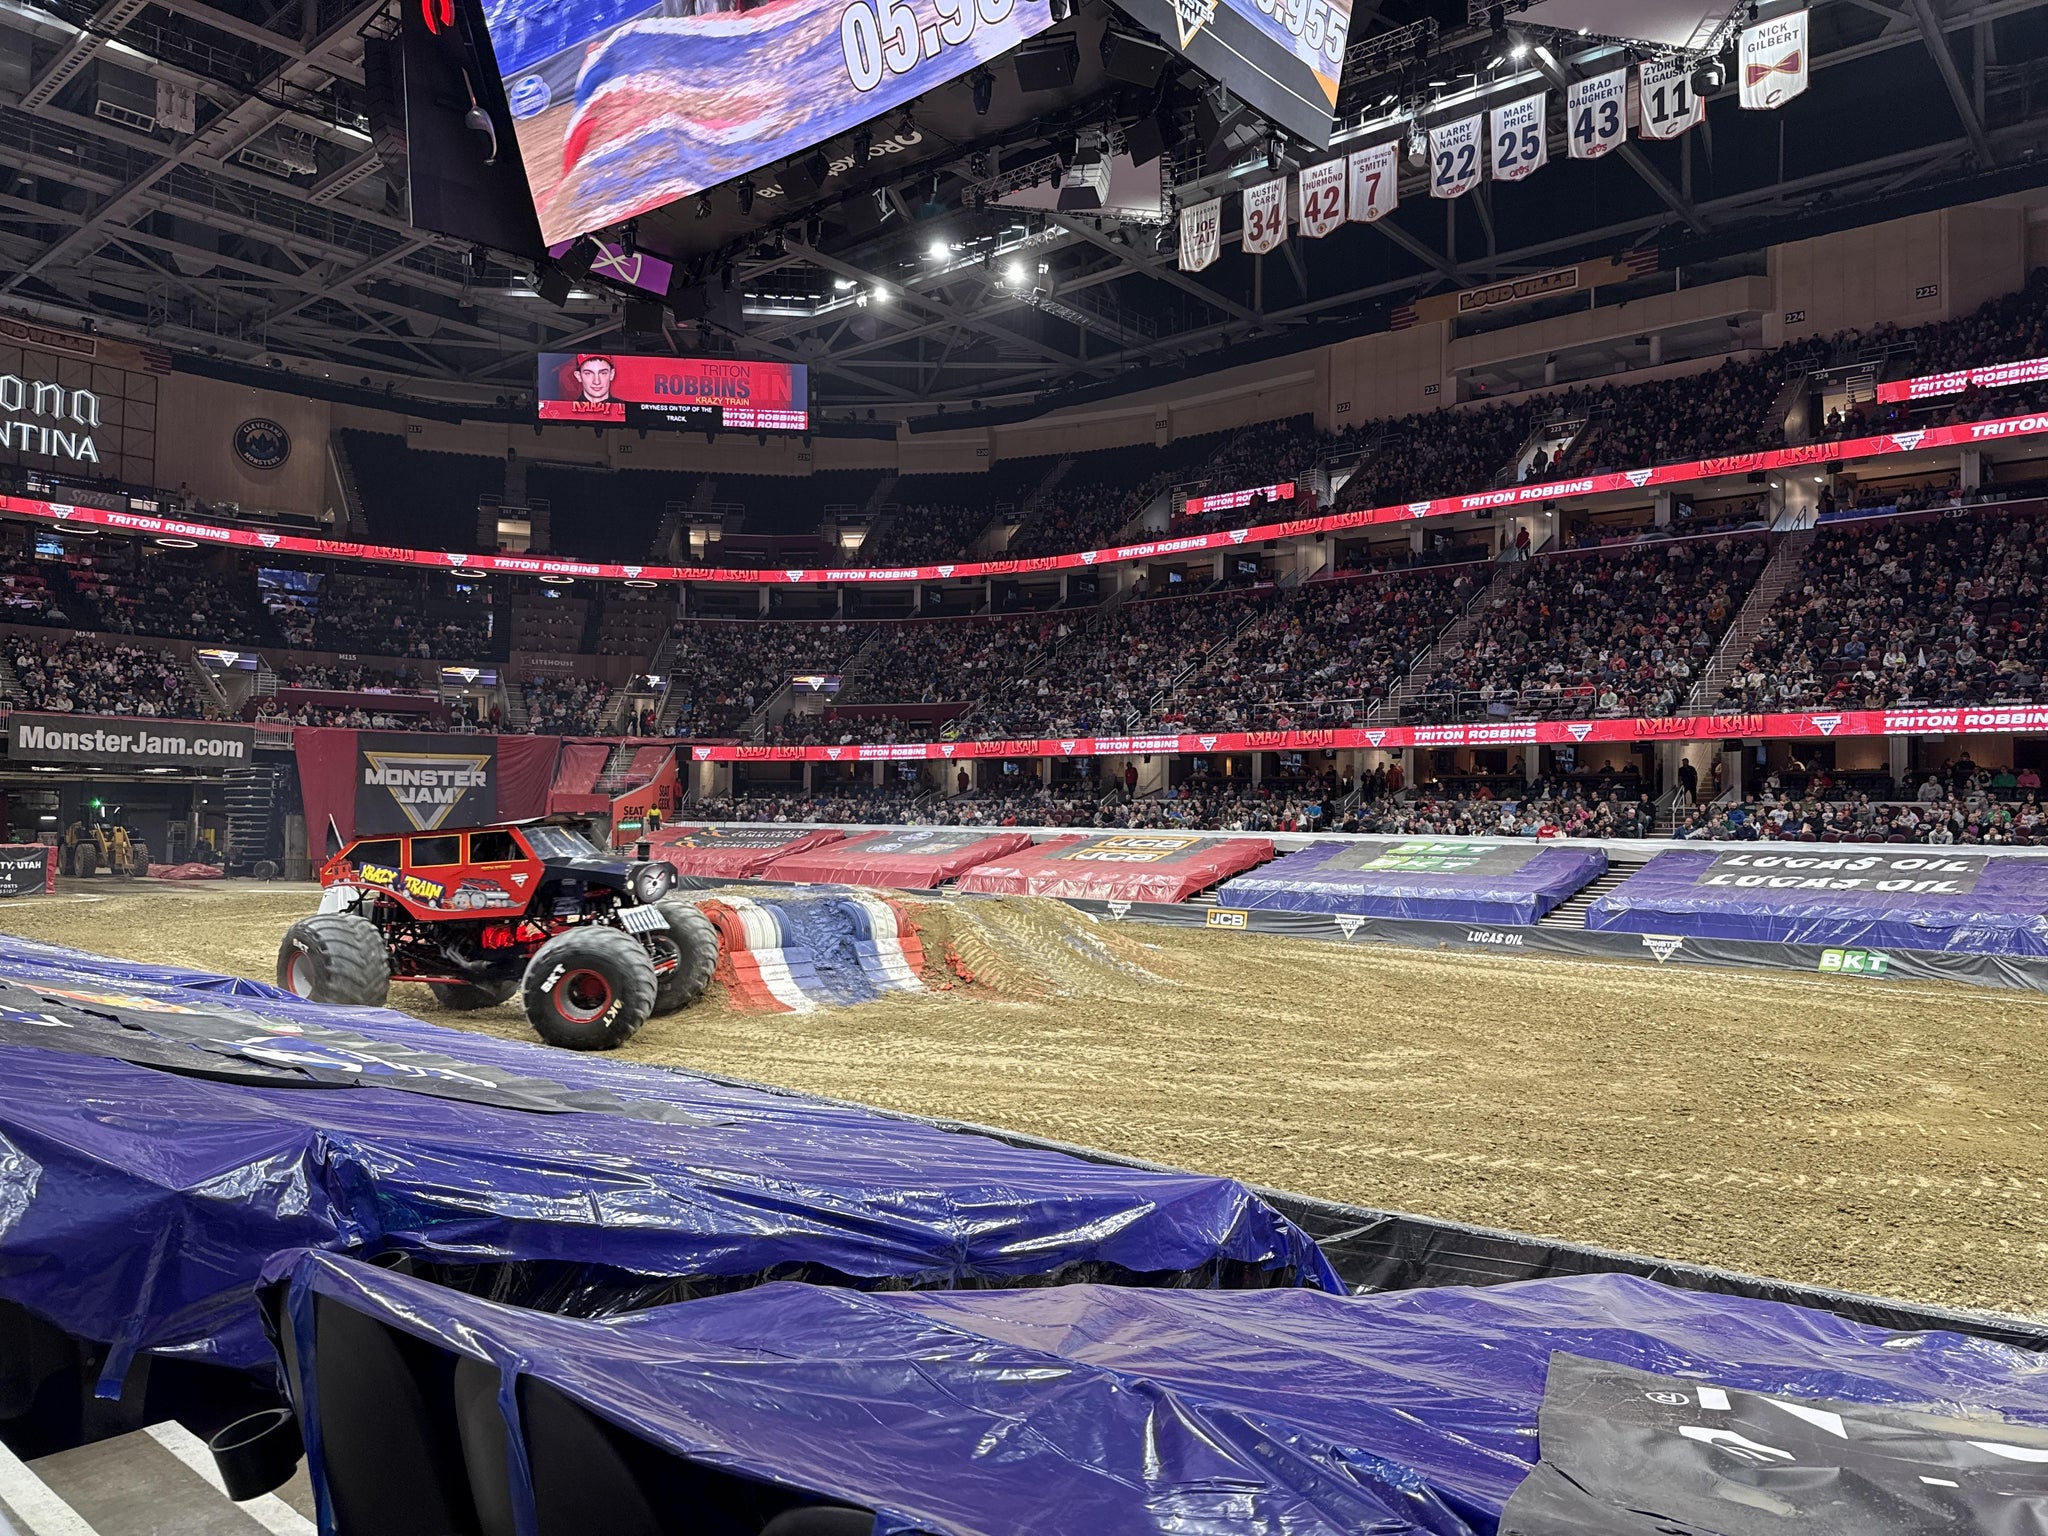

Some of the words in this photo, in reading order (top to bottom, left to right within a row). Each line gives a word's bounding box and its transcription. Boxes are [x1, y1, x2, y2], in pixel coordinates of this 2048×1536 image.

[1758, 22, 1788, 39] NICK
[841, 0, 1014, 92] 05.9
[1747, 30, 1800, 53] GILBERT
[1643, 63, 1699, 86] ILGAUSKAS
[1581, 78, 1611, 95] BRAD
[1569, 84, 1625, 109] DAUGHERTY
[1652, 80, 1690, 124] 11
[1503, 102, 1534, 119] MARK
[1503, 113, 1534, 129] PRICE
[1574, 100, 1620, 145] 43
[1440, 122, 1473, 140] LARRY
[1439, 132, 1473, 149] NANCE
[1498, 123, 1540, 169] 25
[827, 140, 905, 178] Roket
[1353, 156, 1371, 167] BOBBY
[1359, 159, 1388, 174] SMITH
[1436, 144, 1476, 187] 22
[1311, 166, 1333, 180] NATE
[1302, 172, 1344, 192] THURMOND
[1365, 172, 1382, 207] 7
[1251, 184, 1281, 200] AUSTIN
[1254, 194, 1277, 207] CARR
[1304, 186, 1340, 224] 42
[1195, 217, 1216, 234] JOE
[1248, 203, 1282, 242] 34
[1193, 229, 1217, 246] TAIT
[1460, 271, 1576, 311] LOUDVILLE
[1916, 286, 1937, 298] 225
[1786, 312, 1804, 323] 224
[702, 364, 750, 377] TRITON
[1861, 365, 1876, 373] 225
[654, 374, 750, 398] ROBBINS
[1909, 376, 1968, 394] TRITON
[1971, 364, 2048, 384] ROBBINS
[1425, 386, 1439, 394] 223
[641, 403, 668, 412] DRYNESS
[695, 396, 723, 406] KRAZY
[725, 398, 750, 406] TRAIN
[1337, 403, 1350, 412] 222
[723, 411, 755, 420] RITON
[757, 413, 806, 422] ROBBINS
[243, 422, 283, 438] CLEVELAND
[757, 421, 806, 430] ROBBINS
[1970, 416, 2048, 438] TRITON
[243, 452, 281, 466] MONSTERS
[71, 489, 116, 508] Sprite
[1203, 497, 1234, 508] TRITON
[1461, 492, 1516, 508] TRITON
[1519, 480, 1594, 499] ROBBINS
[106, 514, 162, 530] TRITON
[165, 523, 230, 540] ROBBINS
[1117, 545, 1154, 558] TRITON
[1156, 537, 1208, 553] ROBBINS
[493, 559, 540, 570] TRITON
[543, 563, 600, 575] ROBBINS
[825, 571, 867, 580] TRITON
[869, 570, 918, 579] ROBBINS
[339, 653, 357, 661] M115
[531, 658, 575, 667] LITEHOUSE
[1706, 714, 1765, 737] TRAIN
[1883, 714, 1958, 728] TRITON
[19, 725, 244, 758] MonsterJam.com
[1294, 729, 1333, 746] TRAIN
[1414, 730, 1465, 741] TRITON
[1468, 727, 1537, 739] ROBBINS
[776, 746, 805, 760] TRAIN
[859, 749, 889, 757] TRITON
[891, 747, 927, 756] ROBBINS
[1011, 740, 1040, 755] TRAIN
[1094, 740, 1130, 750] TRITON
[1132, 739, 1179, 749] ROBBINS
[364, 767, 487, 787] MONSTER
[399, 787, 454, 804] JAM
[659, 784, 670, 798] SEAT
[623, 805, 645, 816] SEAT
[658, 798, 670, 810] GEEK
[1106, 839, 1189, 848] JCB
[17, 861, 42, 869] UTAH
[1075, 851, 1156, 862] JCB
[1722, 854, 1887, 872] LUCAS
[361, 864, 398, 884] KRAZY
[1705, 873, 1868, 890] LUCAS
[404, 876, 443, 899] TRAIN
[1211, 914, 1244, 925] JCB
[1467, 931, 1504, 944] LUCAS
[1505, 934, 1523, 945] OIL
[1642, 939, 1683, 949] MONSTER
[1824, 952, 1887, 973] BKT
[541, 963, 566, 993] BKT
